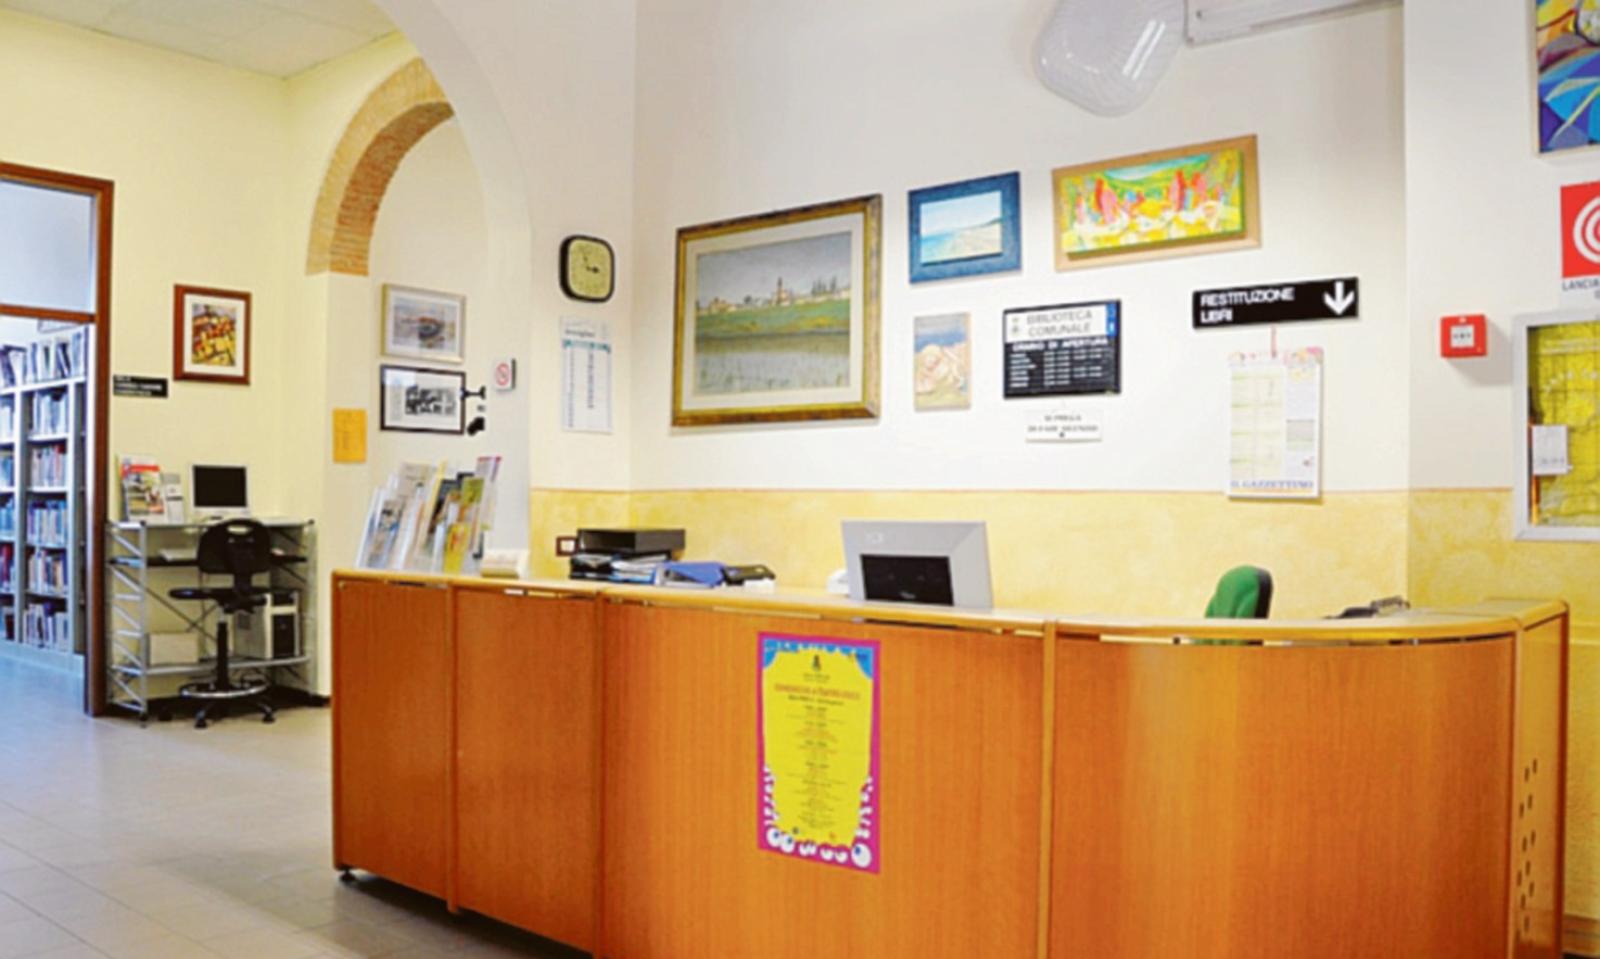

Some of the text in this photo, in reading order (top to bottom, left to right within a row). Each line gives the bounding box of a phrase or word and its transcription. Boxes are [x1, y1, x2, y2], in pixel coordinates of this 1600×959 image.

[1201, 287, 1295, 307] RESTITUZIONE
[1026, 309, 1093, 326] BIBLIOTECA
[1201, 308, 1233, 323] LIBRI
[1027, 322, 1091, 338] COMUNALE
[1242, 479, 1314, 490] GAZZETTINO
